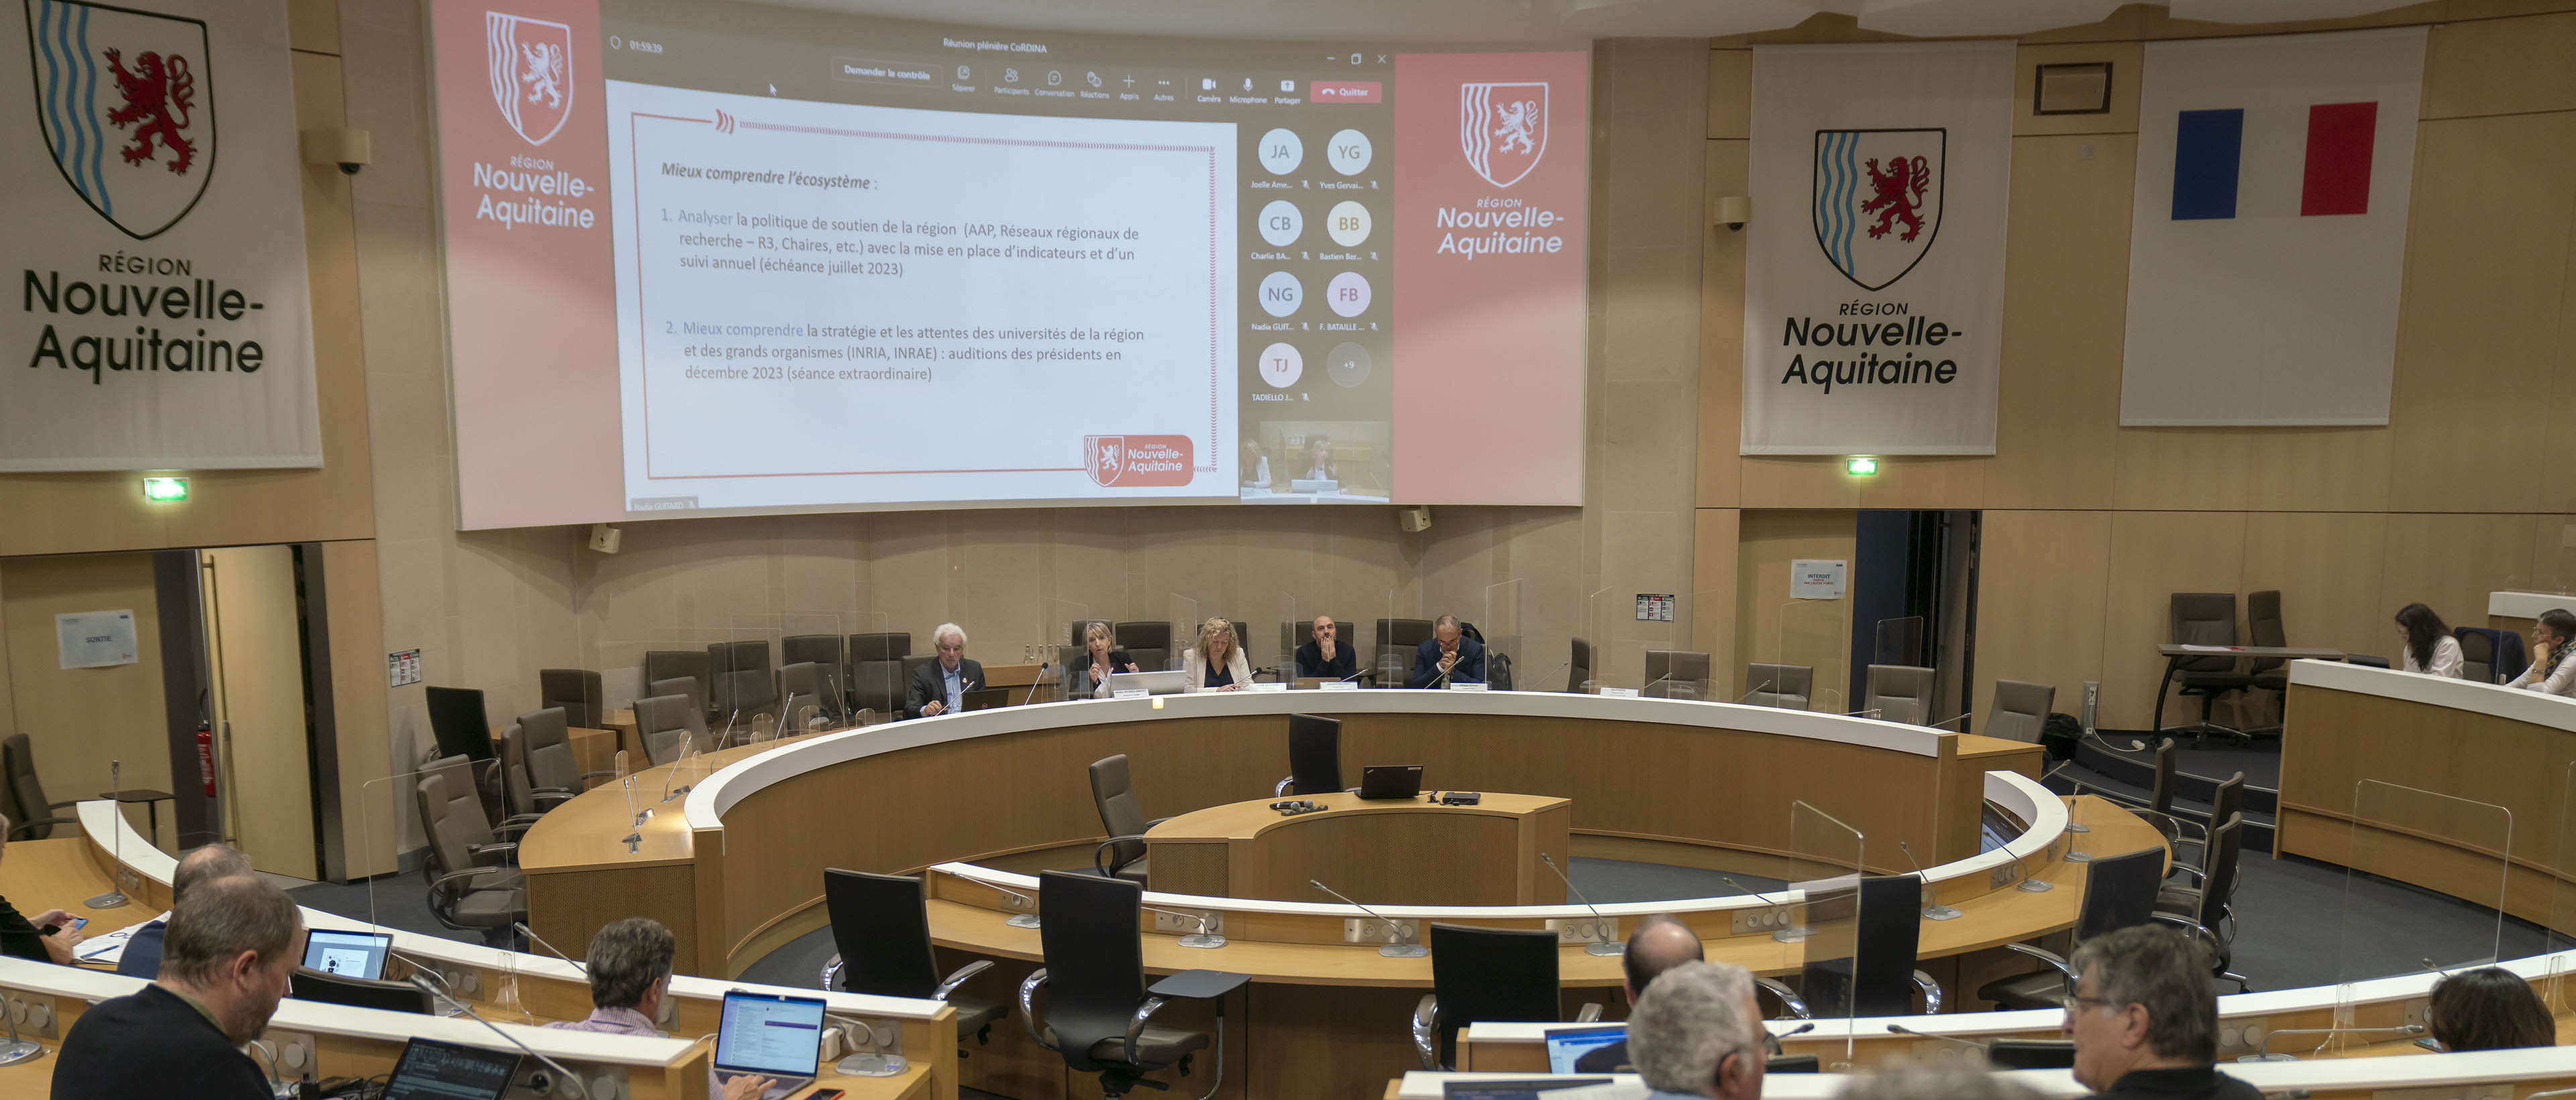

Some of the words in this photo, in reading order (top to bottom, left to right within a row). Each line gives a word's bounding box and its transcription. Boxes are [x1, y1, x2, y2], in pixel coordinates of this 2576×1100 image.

[943, 38, 975, 49] Réunion
[977, 41, 1008, 51] plénière
[1010, 42, 1047, 54] CoRDINA
[845, 65, 885, 76] Demander
[888, 68, 896, 77] le
[897, 70, 930, 80] contrôle
[994, 86, 1029, 97] Participants
[1035, 88, 1075, 97] Conversation
[1080, 90, 1110, 99] Réactions
[1154, 93, 1174, 101] Autres
[1340, 87, 1368, 98] Quitter
[1197, 95, 1221, 103] Caméra
[1230, 96, 1267, 105] Microphone
[1275, 97, 1301, 105] Partager
[1271, 145, 1290, 159] JA
[1338, 146, 1360, 160] YG
[511, 154, 553, 170] RÉGION
[473, 162, 594, 197] Nouvelle-
[661, 162, 702, 178] Mieux
[706, 166, 784, 184] comprendre
[1477, 196, 1522, 208] RÉGION
[476, 193, 594, 230] Aquitaine
[1436, 207, 1564, 228] Nouvelle-
[661, 208, 672, 222] 1.
[678, 209, 733, 227] Analyser
[737, 212, 747, 226] la
[751, 213, 808, 231] politique
[812, 216, 827, 230] de
[831, 218, 878, 232] soutien
[882, 220, 898, 233] de
[902, 220, 912, 234] la
[916, 221, 956, 237] région
[964, 223, 997, 238] (AAP,
[1001, 225, 1053, 238] Réseaux
[1057, 225, 1120, 241] régionaux
[1123, 227, 1138, 240] de
[1270, 217, 1291, 230] CB
[1339, 217, 1360, 231] BB
[680, 233, 743, 248] recherche
[758, 236, 778, 252] R3,
[782, 237, 832, 254] Chaires,
[837, 239, 864, 256] etc.)
[867, 243, 896, 254] avec
[900, 241, 910, 255] la
[914, 243, 943, 256] mise
[947, 246, 963, 257] en
[967, 244, 1001, 259] place
[1090, 248, 1103, 260] et
[1438, 231, 1562, 260] Aquitaine
[99, 250, 191, 276] RÉGION
[680, 255, 708, 268] suivi
[712, 257, 756, 270] annuel
[759, 257, 824, 274] (échéance
[827, 260, 863, 276] juillet
[867, 262, 903, 278] 2023)
[23, 270, 264, 321] Nouvelle-
[1268, 288, 1293, 301] NG
[1340, 288, 1358, 301] FB
[1839, 299, 1909, 316] RÉGION
[665, 321, 677, 335] 2.
[683, 321, 722, 335] Mieux
[726, 323, 803, 338] comprendre
[807, 323, 818, 337] la
[822, 325, 876, 340] stratégie
[880, 327, 892, 338] et
[896, 325, 913, 338] les
[917, 327, 969, 339] attentes
[973, 326, 995, 339] des
[999, 327, 1066, 340] universités
[1070, 328, 1085, 340] de
[1089, 328, 1100, 340] la
[1104, 328, 1144, 343] région
[1783, 315, 1962, 346] Nouvelle-
[29, 325, 263, 385] Aquitaine
[684, 345, 697, 357] et
[700, 343, 722, 357] des
[726, 344, 768, 360] grands
[771, 347, 843, 361] organismes
[847, 346, 890, 361] (INRIA,
[894, 346, 937, 362] INRAE)
[949, 347, 1007, 360] auditions
[1011, 347, 1032, 360] des
[1036, 348, 1102, 362] présidents
[1106, 351, 1122, 360] en
[1273, 359, 1288, 372] TJ
[1343, 361, 1354, 369] +9
[685, 366, 748, 380] décembre
[752, 366, 784, 380] 2023
[787, 366, 835, 382] (séance
[839, 366, 932, 382] extraordinaire)
[1782, 351, 1957, 394] Aquitaine
[1128, 449, 1183, 459] Nouvelle-
[1128, 461, 1183, 475] Aquitaine
[86, 635, 113, 644] SORTIE
